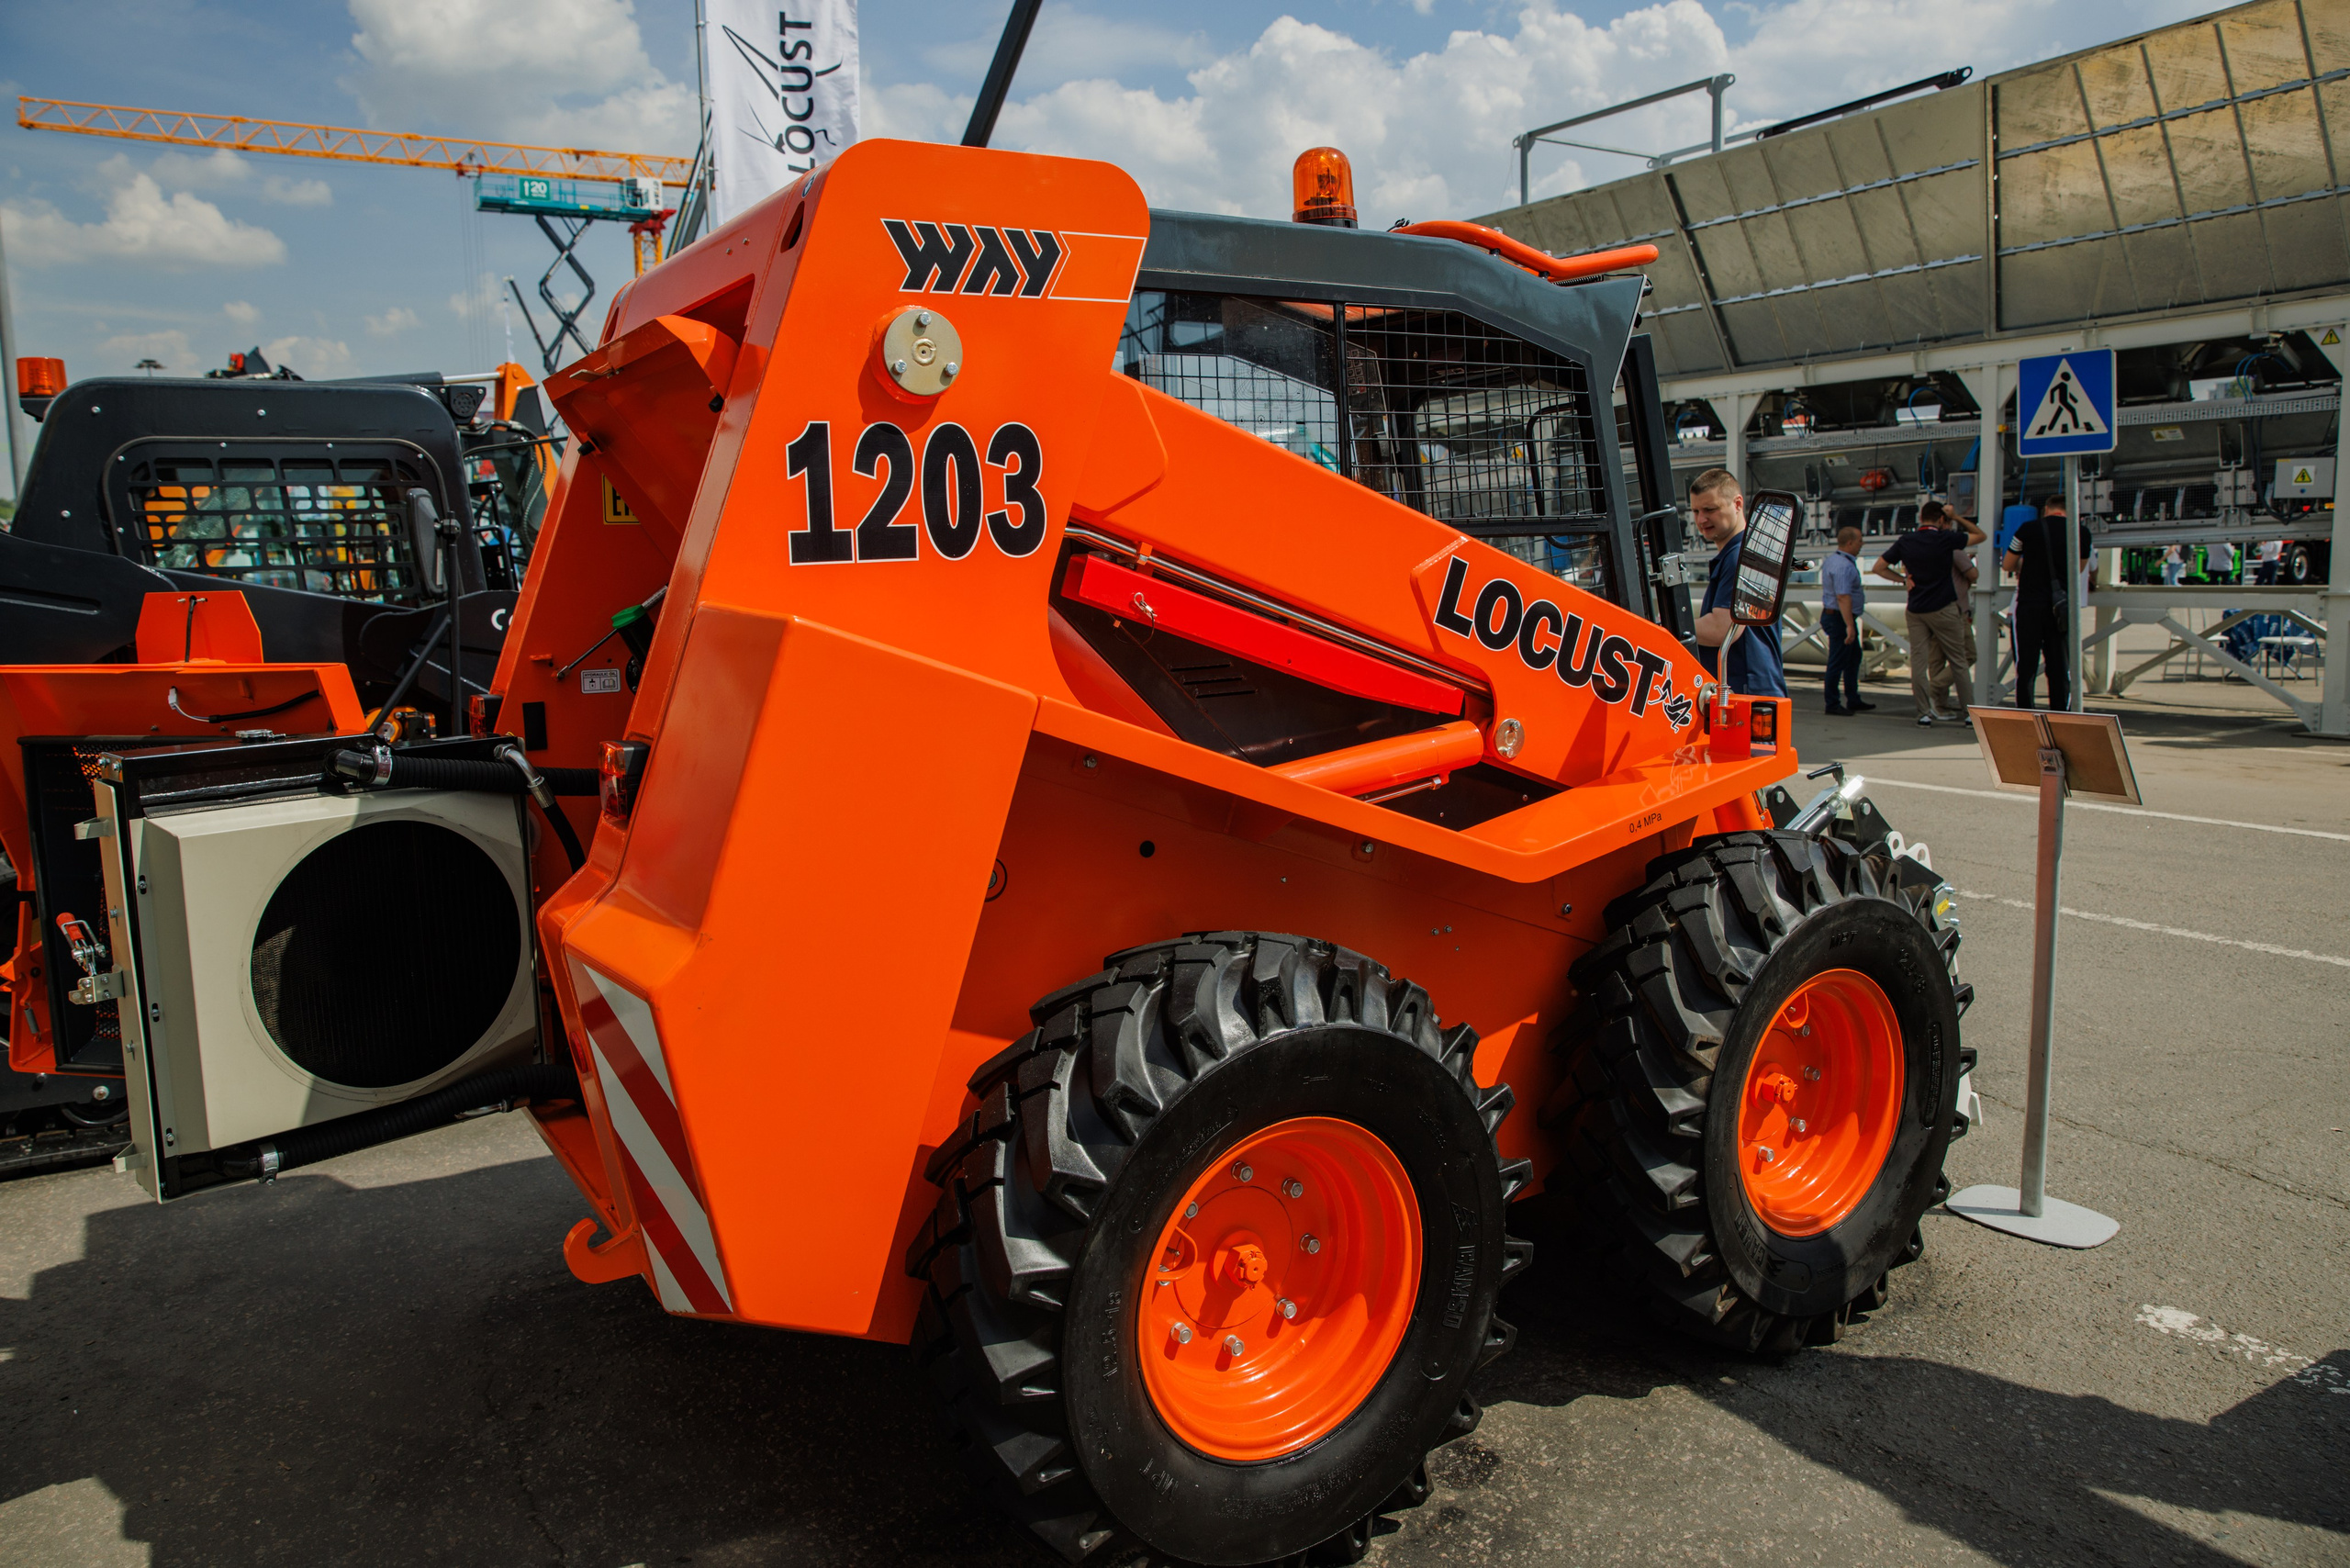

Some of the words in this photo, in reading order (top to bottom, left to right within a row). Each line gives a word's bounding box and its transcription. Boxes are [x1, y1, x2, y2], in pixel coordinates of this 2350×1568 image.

[778, 11, 815, 174] LOCUST
[530, 181, 548, 194] 20
[881, 218, 1064, 298] WAY
[787, 420, 1047, 566] 1203
[491, 608, 513, 632] C
[1434, 555, 1668, 718] LOCUST
[1628, 819, 1642, 834] 0,4
[1643, 812, 1662, 827] MPa
